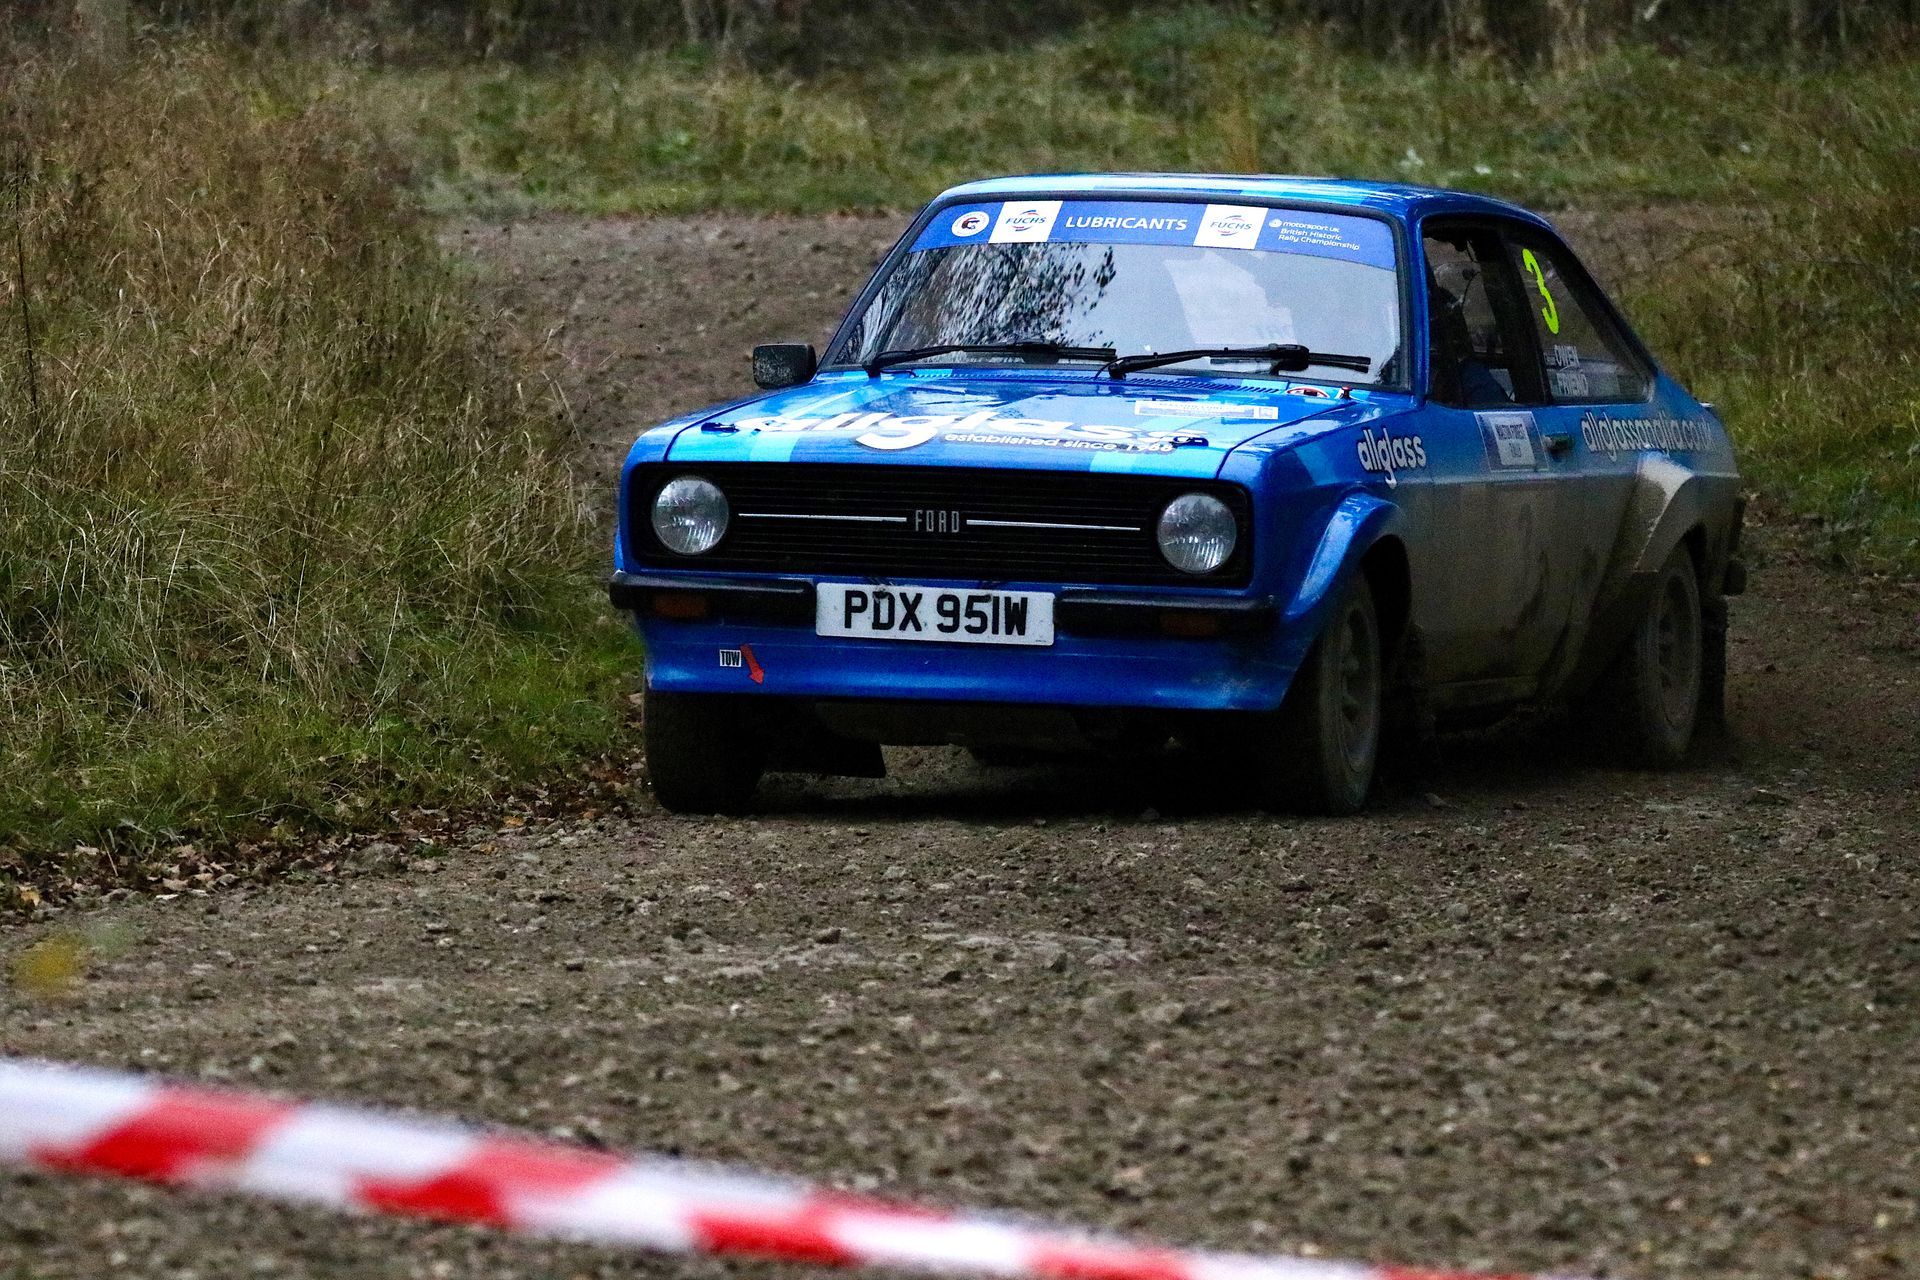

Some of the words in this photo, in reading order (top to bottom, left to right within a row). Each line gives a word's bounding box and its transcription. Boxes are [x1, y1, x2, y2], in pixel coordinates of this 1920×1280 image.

[1065, 216, 1188, 231] LUBRICANTS
[1209, 221, 1253, 230] FUCHS
[1282, 220, 1329, 232] motorsport
[1278, 234, 1299, 243] Rally
[1300, 236, 1360, 251] Championship
[1280, 228, 1308, 236] British
[1309, 230, 1343, 241] Historic
[1522, 248, 1560, 334] 3
[944, 433, 1060, 448] established
[1063, 440, 1117, 450] since
[1357, 428, 1427, 489] allglass
[915, 509, 960, 533] FORD
[844, 589, 923, 632] PDX
[936, 595, 1028, 636] 951W
[720, 650, 741, 667] TOW
